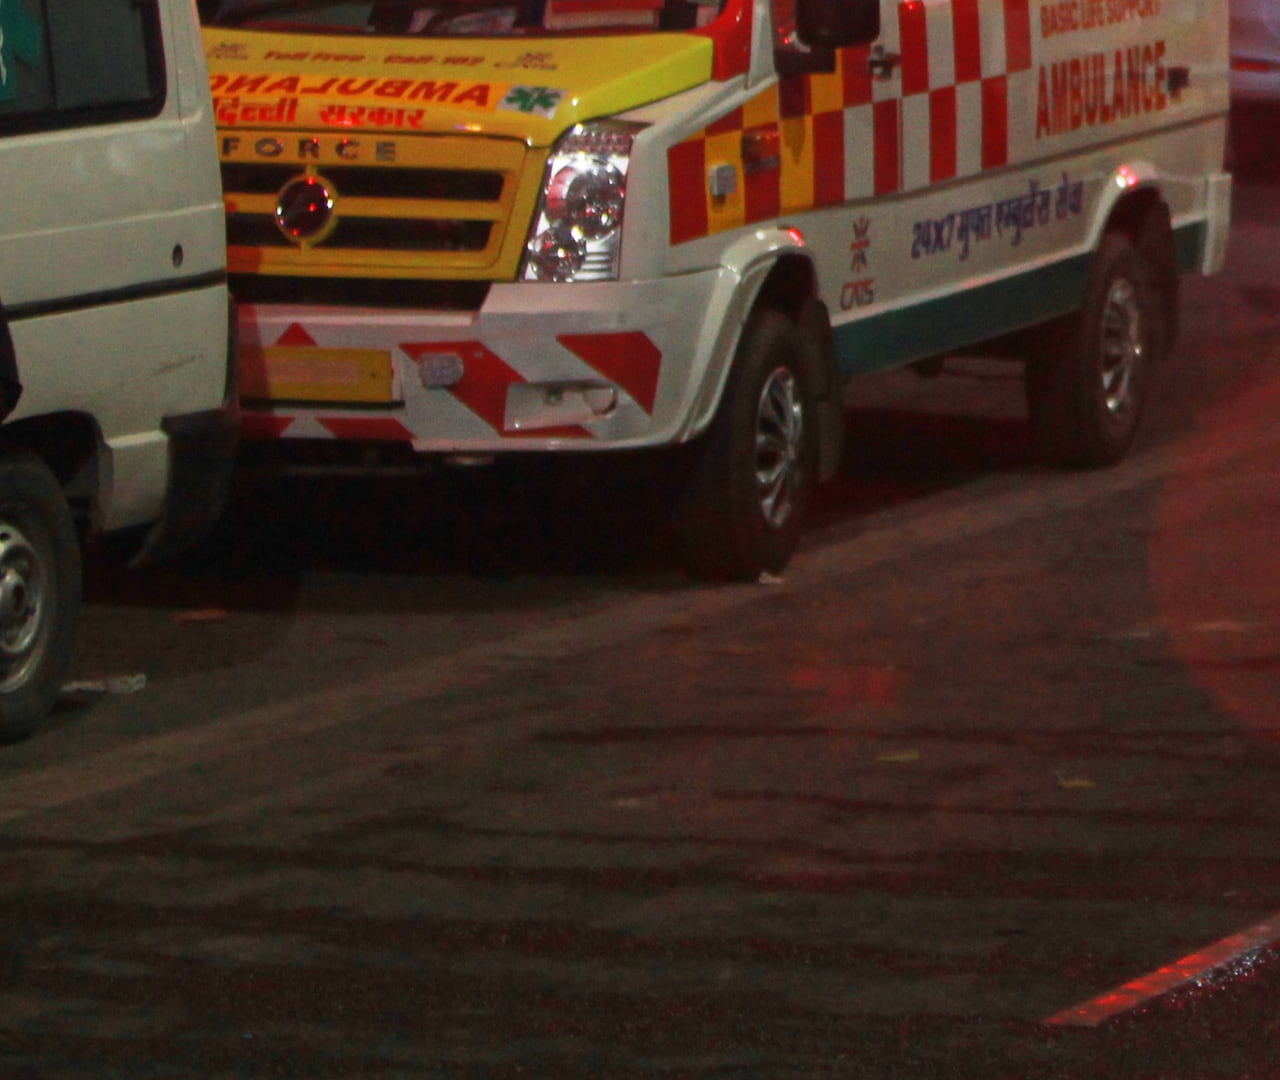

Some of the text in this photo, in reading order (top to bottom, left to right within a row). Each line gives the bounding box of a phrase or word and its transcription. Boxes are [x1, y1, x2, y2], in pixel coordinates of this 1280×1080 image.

[1040, 0, 1079, 39] BASIC
[1036, 40, 1167, 140] AMBULANCE
[319, 104, 426, 130] सरकार
[222, 136, 397, 162] FORCE
